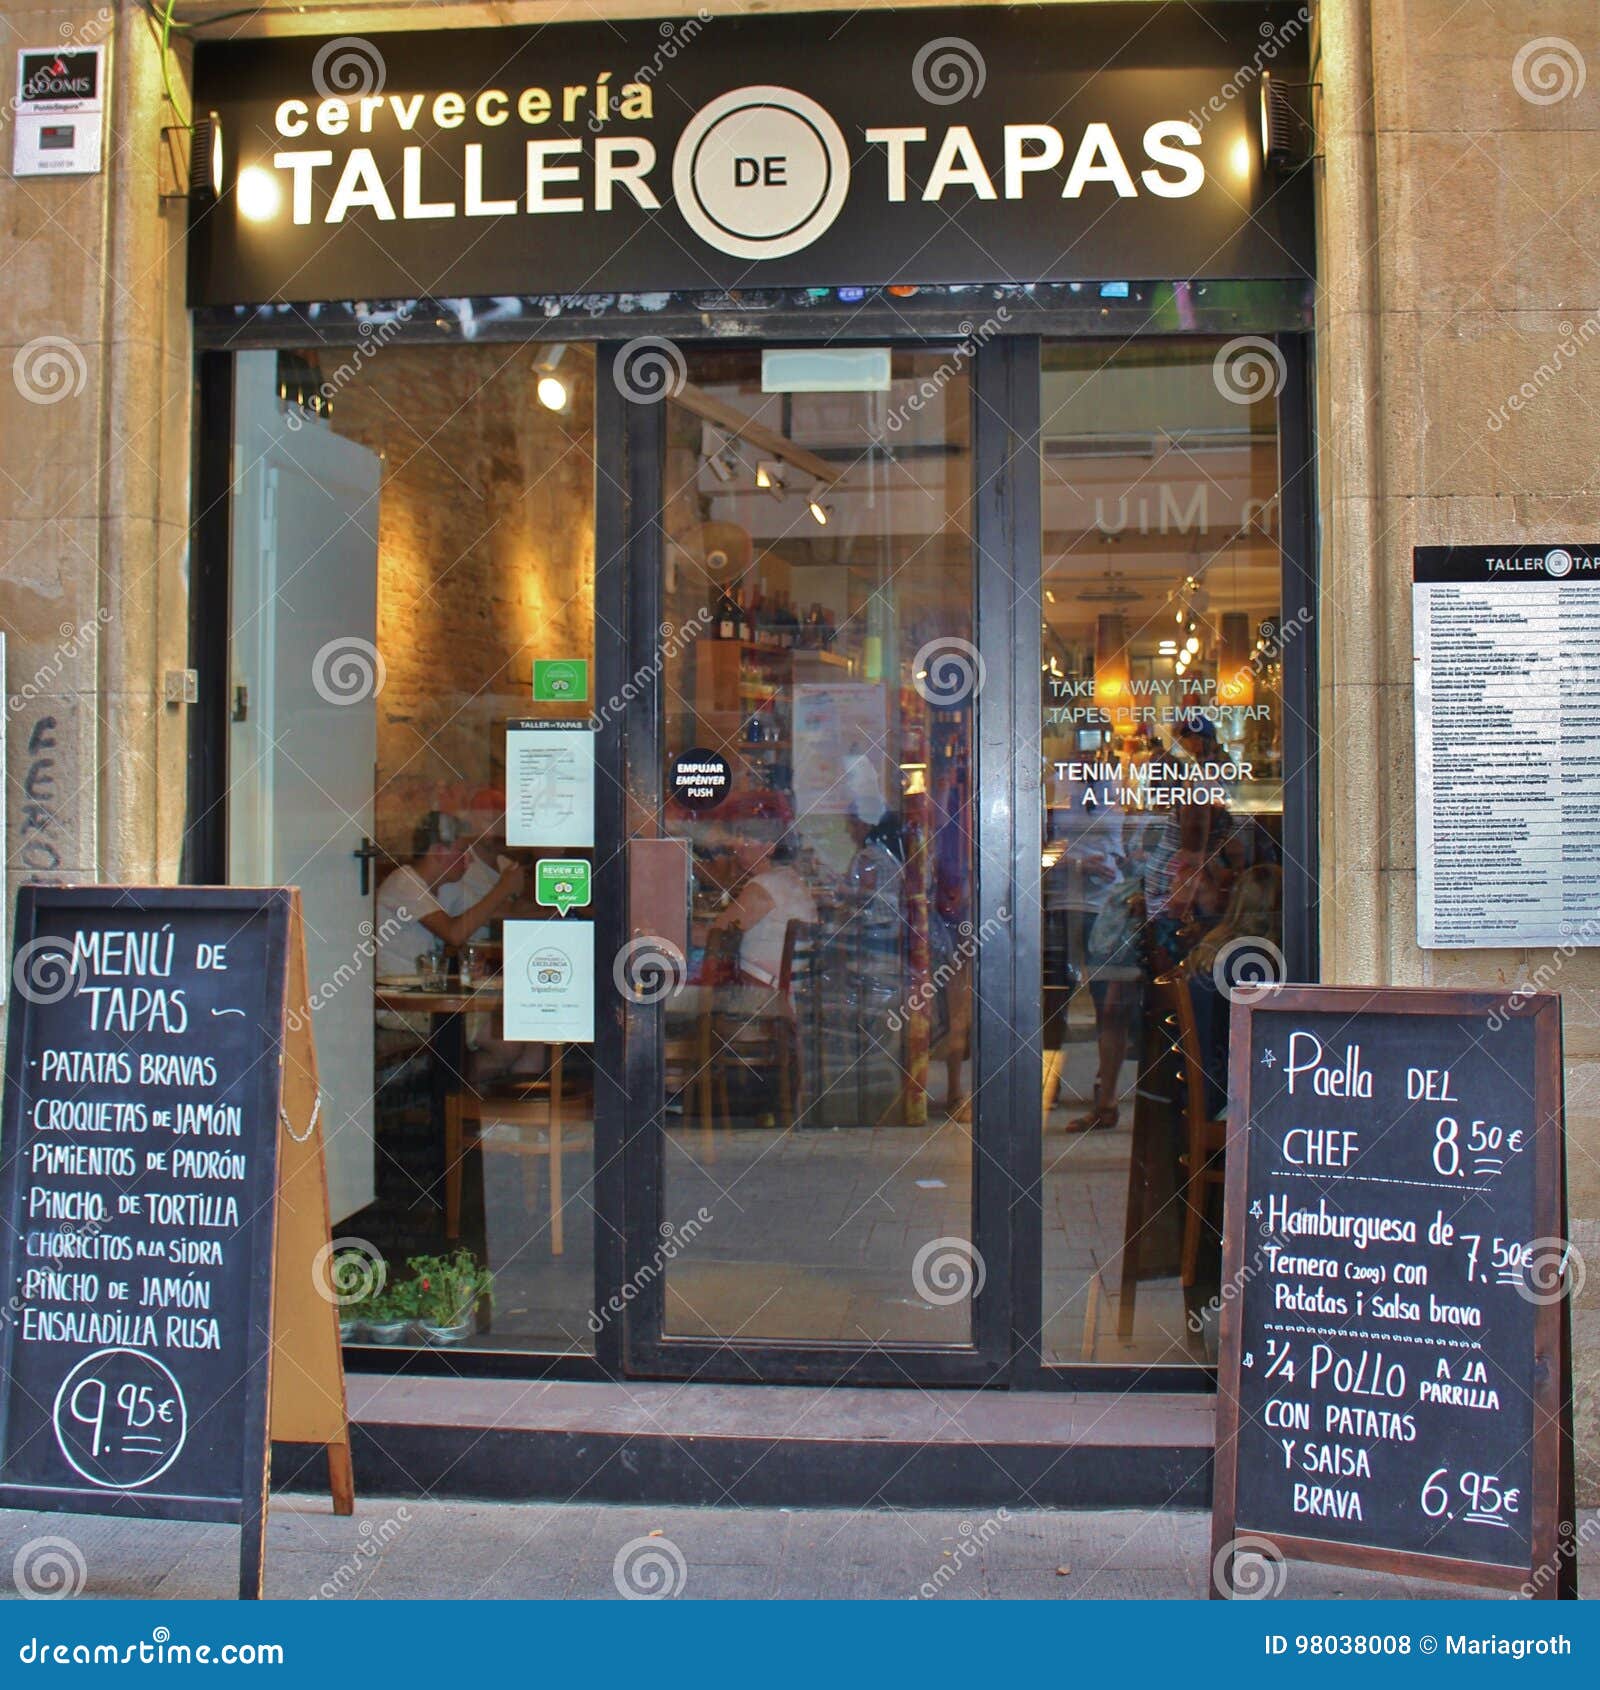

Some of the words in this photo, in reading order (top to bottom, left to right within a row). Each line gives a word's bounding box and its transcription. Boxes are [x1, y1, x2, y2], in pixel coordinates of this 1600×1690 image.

[274, 72, 655, 138] cervecería
[274, 136, 661, 225] TALLER
[734, 156, 788, 188] DE
[865, 120, 1206, 203] TAPAS
[1486, 557, 1544, 571] TALLER
[1050, 707, 1112, 725] TAPES
[1117, 706, 1157, 723] PER
[1162, 704, 1272, 723] EMPORTAR
[677, 763, 724, 774] EMPUJAR
[1054, 762, 1123, 782] TENIM
[1129, 761, 1254, 781] MENJADOR
[687, 787, 714, 798] PUSH
[1081, 788, 1098, 807] A
[69, 923, 176, 978] MENÚ
[196, 944, 229, 971] DE
[78, 987, 189, 1034] TAPAS
[41, 1050, 133, 1084] PATATAS
[139, 1053, 218, 1087] BRAVAS
[1283, 1031, 1374, 1099] Paella
[1406, 1067, 1460, 1102] DEL
[33, 1098, 149, 1133] CROQUETAS
[152, 1110, 172, 1128] DE
[172, 1103, 243, 1137] JAMÓN
[146, 1151, 169, 1171] DE
[172, 1149, 247, 1181] PADRÓN
[1282, 1128, 1361, 1168] CHEF
[29, 1186, 103, 1222] PINCHO
[118, 1194, 142, 1215] DE
[143, 1192, 240, 1228] TORTILLA
[1269, 1193, 1417, 1250] Hamburguesa
[1428, 1209, 1455, 1247] de
[168, 1237, 225, 1266] SIDRA
[1263, 1245, 1339, 1280] Ternera
[25, 1268, 100, 1303] PINCHO
[108, 1281, 130, 1301] DE
[139, 1271, 211, 1311] JAMÓN
[1274, 1283, 1349, 1316] Patatas
[1429, 1293, 1482, 1328] brava
[22, 1308, 159, 1347] ENSALADILLA
[166, 1315, 222, 1350] RUSA
[1310, 1344, 1407, 1399] POLLO
[1436, 1357, 1452, 1380] A
[1462, 1360, 1489, 1384] LA
[1419, 1380, 1501, 1411] PARRILLA
[1264, 1399, 1310, 1431] CON
[1326, 1404, 1417, 1442] PATATAS
[1281, 1438, 1297, 1470] Y
[1293, 1482, 1364, 1521] BRAVA
